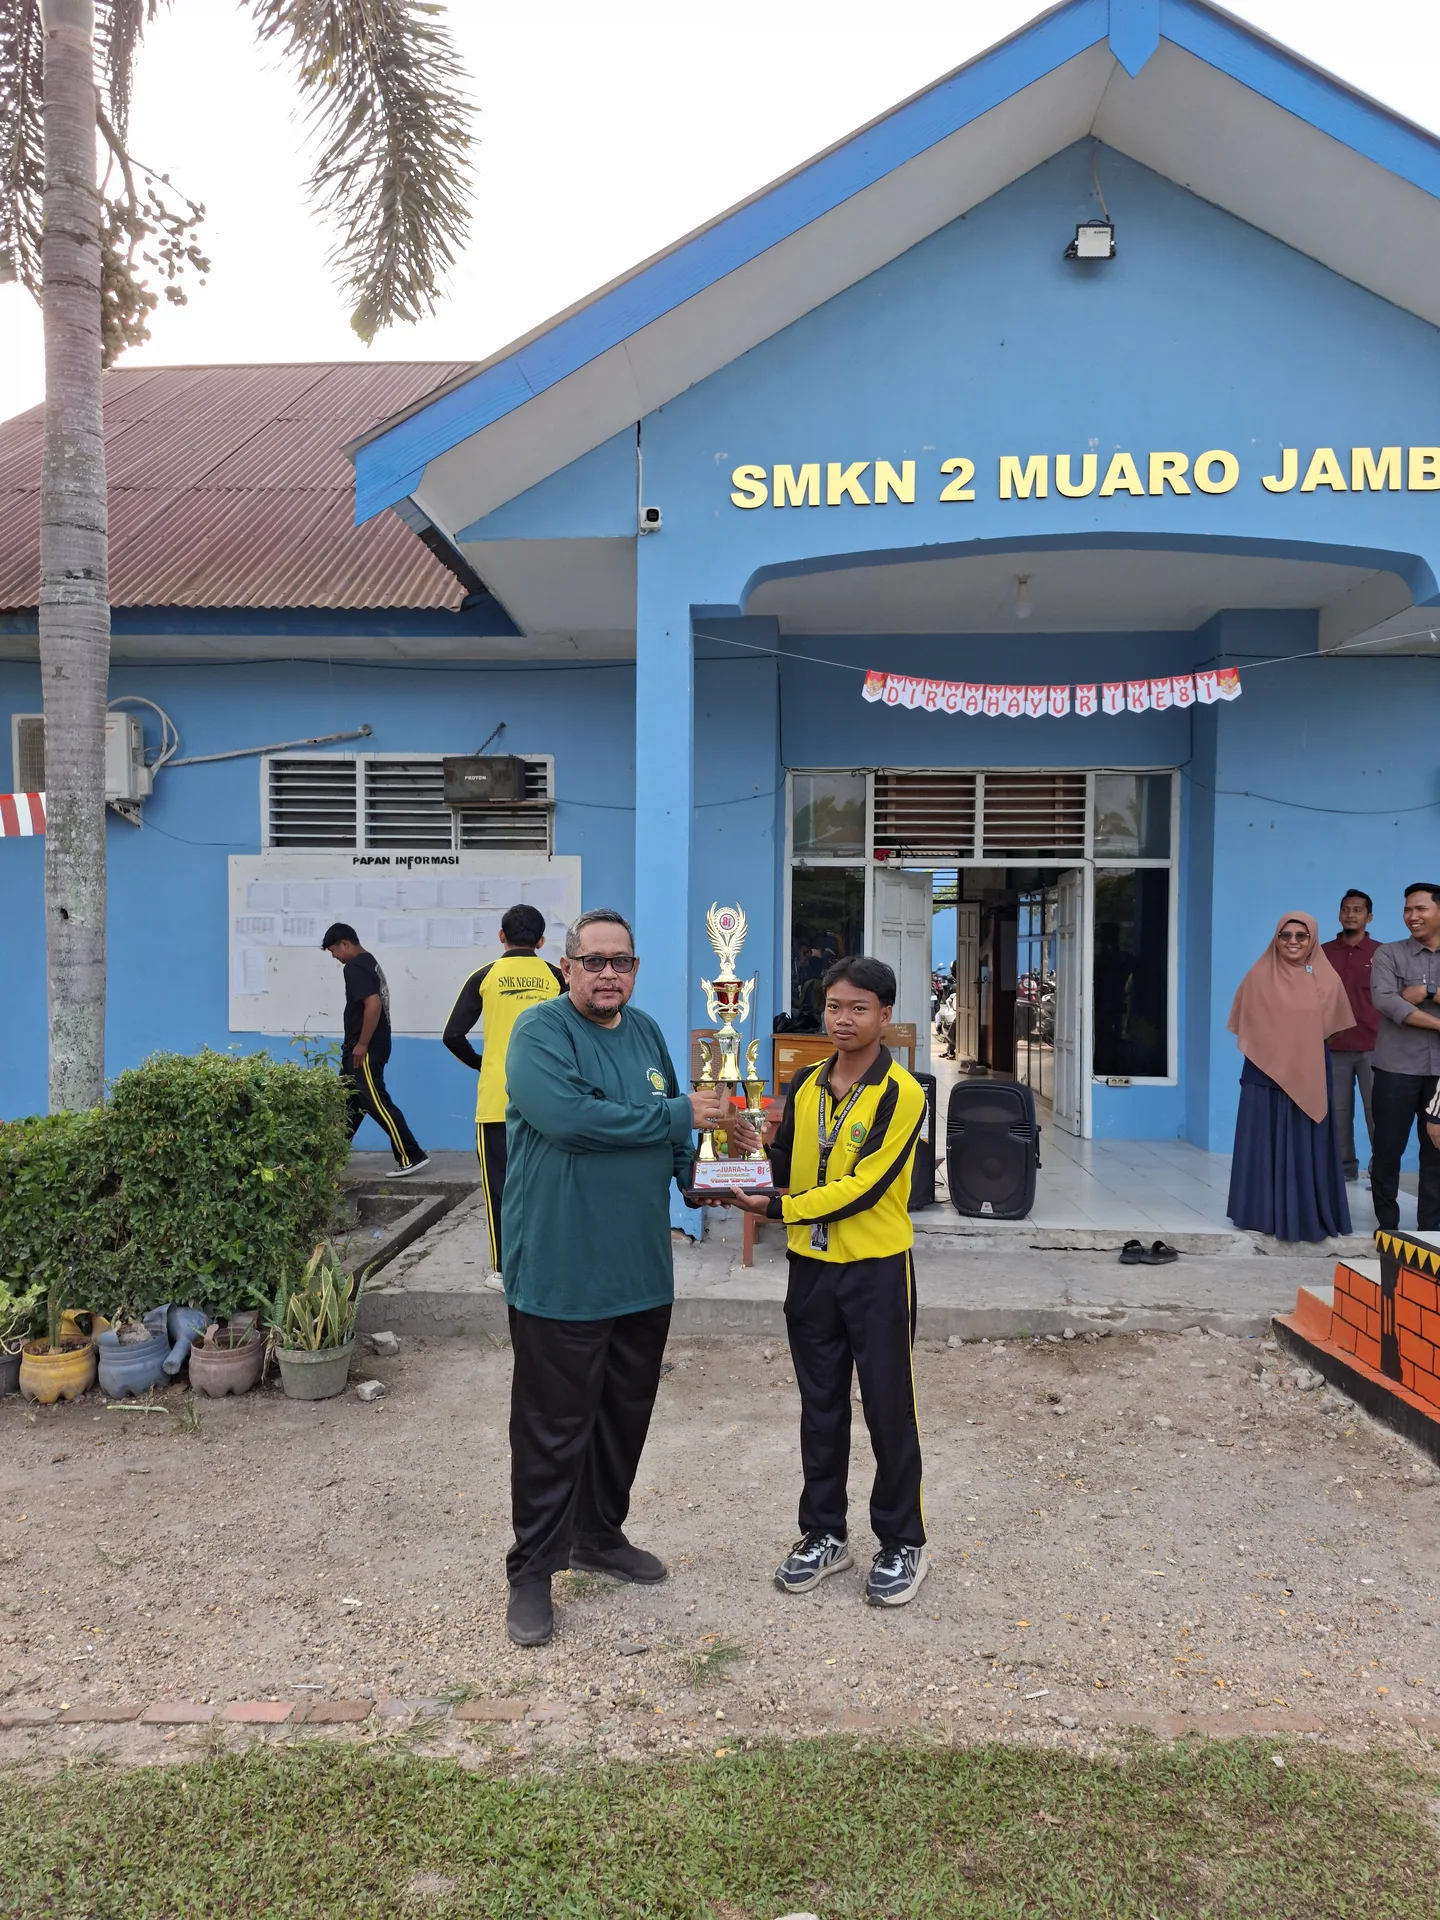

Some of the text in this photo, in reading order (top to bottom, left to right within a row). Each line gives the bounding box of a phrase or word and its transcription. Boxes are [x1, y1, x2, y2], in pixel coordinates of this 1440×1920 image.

[730, 447, 1440, 509] SMKN 2 MUARO JAMB
[887, 686, 1065, 714] DIRGAHAYU
[353, 856, 459, 870] PAPAN INFORMASI
[498, 976, 550, 990] SMK NEGERI 2
[846, 1100, 855, 1111] OSIS
[852, 1092, 860, 1101] SMK
